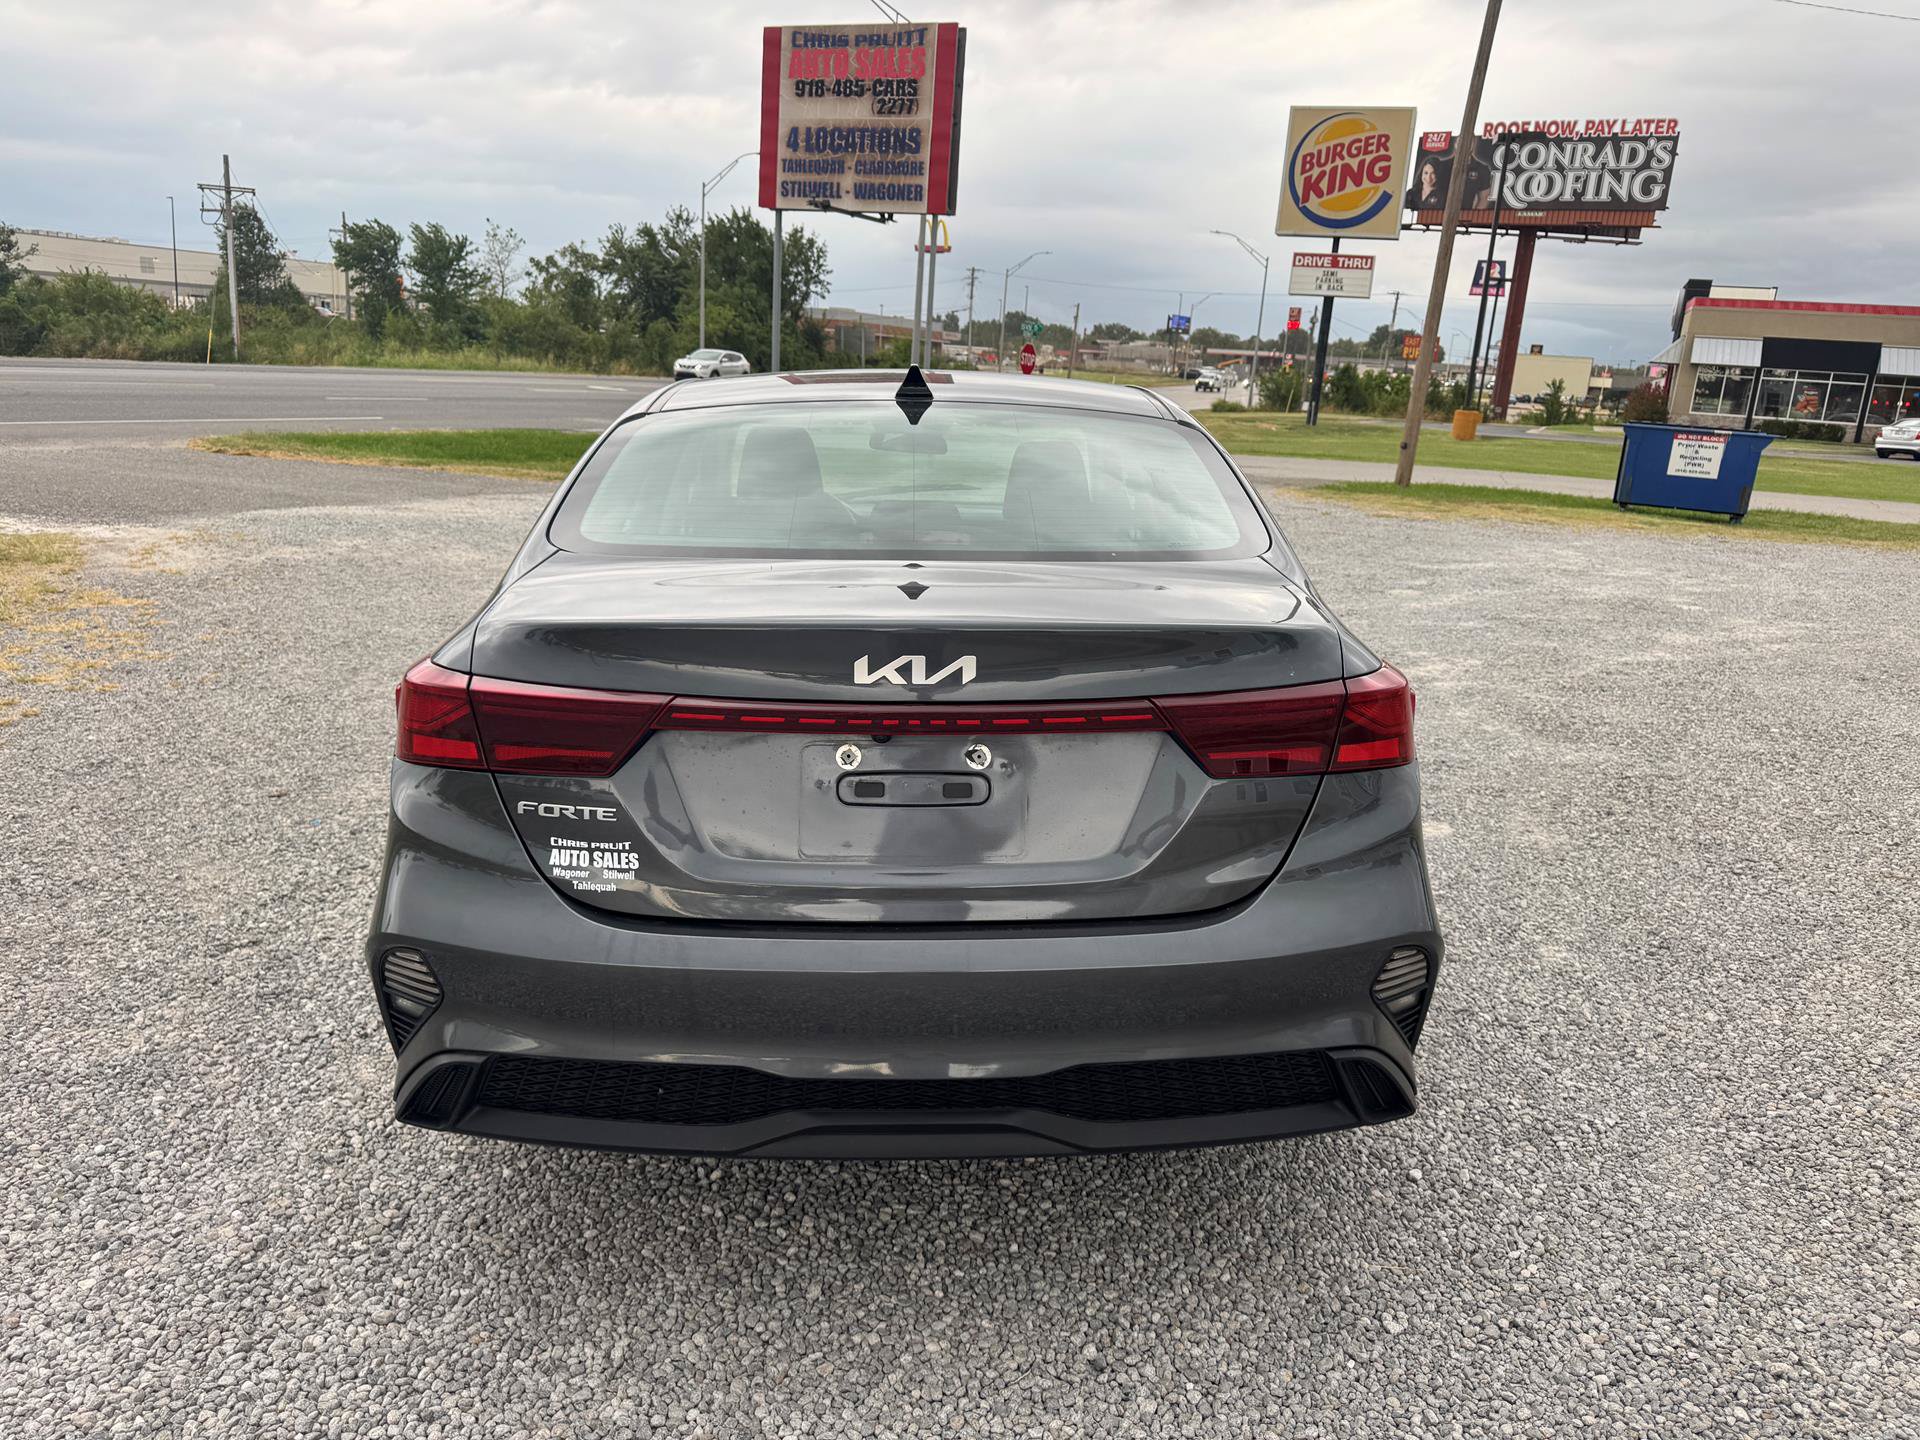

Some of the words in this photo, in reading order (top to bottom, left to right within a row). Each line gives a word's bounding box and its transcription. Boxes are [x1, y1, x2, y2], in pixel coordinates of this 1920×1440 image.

[791, 30, 849, 48] CHRIS
[854, 28, 928, 48] PRUITT
[788, 48, 849, 80] AUTO
[855, 47, 926, 79] SALES
[795, 78, 918, 98] 918-485-CARS
[871, 98, 919, 115] (2277)
[1427, 133, 1447, 142] 24/7
[1482, 121, 1531, 139] ROOF
[1532, 119, 1583, 140] NOW,
[1583, 118, 1618, 137] PAY
[1619, 117, 1680, 137] LATER
[787, 127, 800, 152] 4
[804, 126, 922, 155] LOCATIONS
[1301, 133, 1391, 176] BURGER
[1492, 137, 1674, 171] CONRAD'S
[781, 158, 845, 175] TAHLEQUAH
[855, 159, 925, 177] CLAREMORE
[1300, 154, 1393, 205] KING
[1487, 169, 1666, 209] ROOFING
[780, 180, 842, 200] STILWELL
[854, 182, 923, 202] WAGONER
[1295, 255, 1332, 267] DRIVE
[1337, 257, 1372, 268] THRU
[1021, 352, 1036, 366] STOP
[854, 655, 976, 684] KIA
[517, 801, 617, 821] FORTE
[550, 837, 589, 848] CHRIS
[591, 841, 632, 850] PRUIT
[549, 849, 590, 868] AUTO
[593, 851, 640, 870] SALES
[552, 867, 590, 880] Wagoner
[603, 869, 635, 880] Stilwell
[572, 880, 617, 893] Tahlequah
